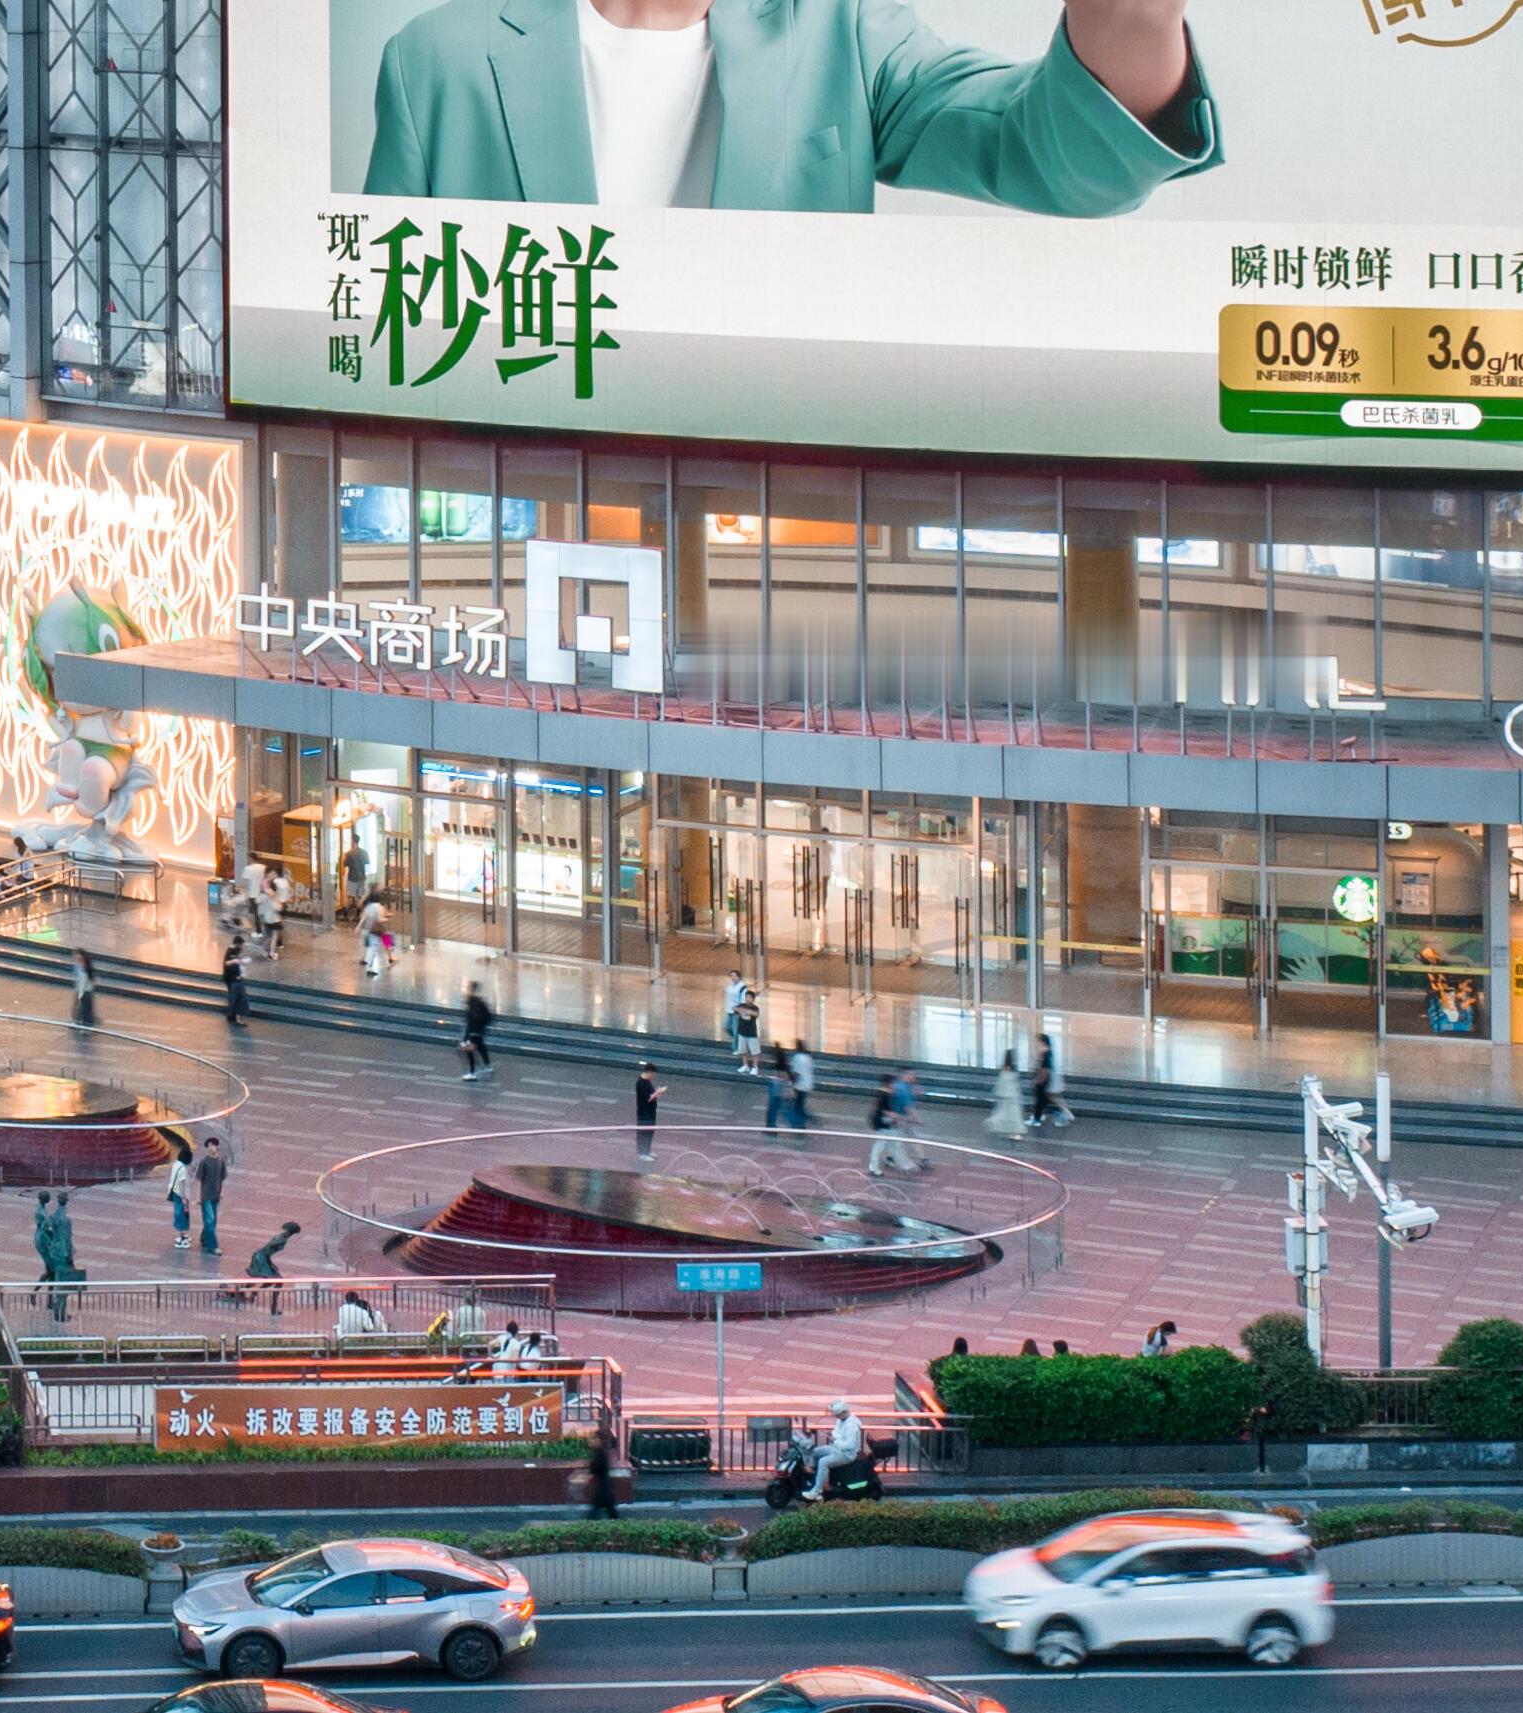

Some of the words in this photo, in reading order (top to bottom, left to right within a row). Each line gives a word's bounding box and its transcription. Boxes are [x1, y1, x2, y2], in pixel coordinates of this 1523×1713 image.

[1231, 245, 1392, 292] 瞬时锁鲜
[369, 216, 620, 400] 秒鲜
[1362, 406, 1460, 426] 巴氏杀菌乳
[235, 582, 510, 680] 中央商场
